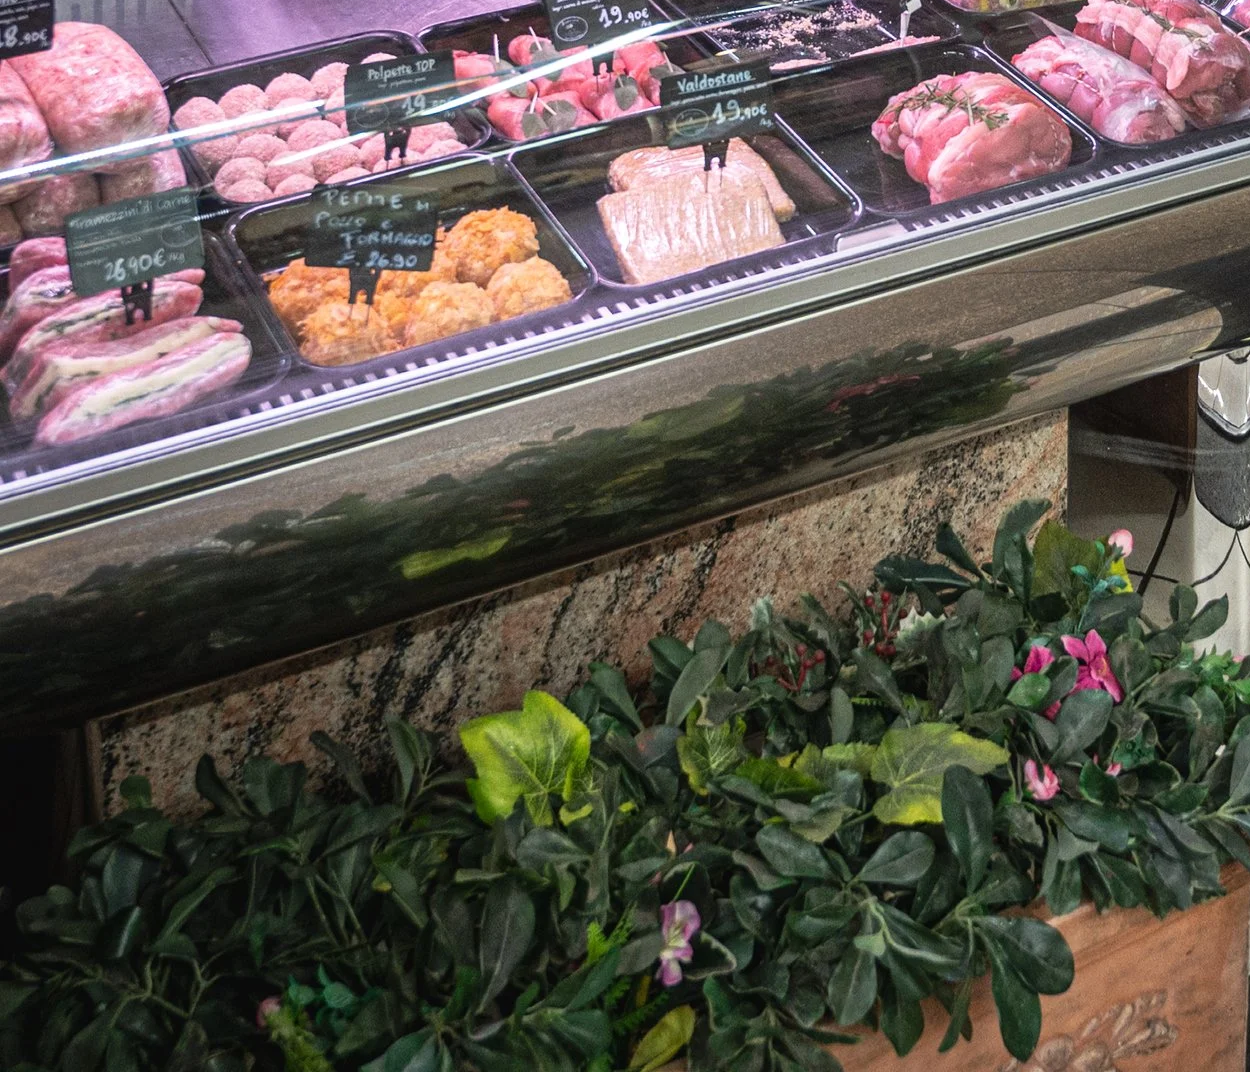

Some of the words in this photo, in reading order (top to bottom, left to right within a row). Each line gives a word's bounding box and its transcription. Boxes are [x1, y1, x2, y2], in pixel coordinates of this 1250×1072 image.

[599, 5, 650, 29] 19.90€
[0, 25, 48, 49] 8.90€
[368, 65, 413, 83] Polpette
[416, 58, 436, 74] TOP
[677, 70, 753, 93] Valdostane
[712, 99, 768, 125] 19.90€
[157, 193, 191, 210] Carne
